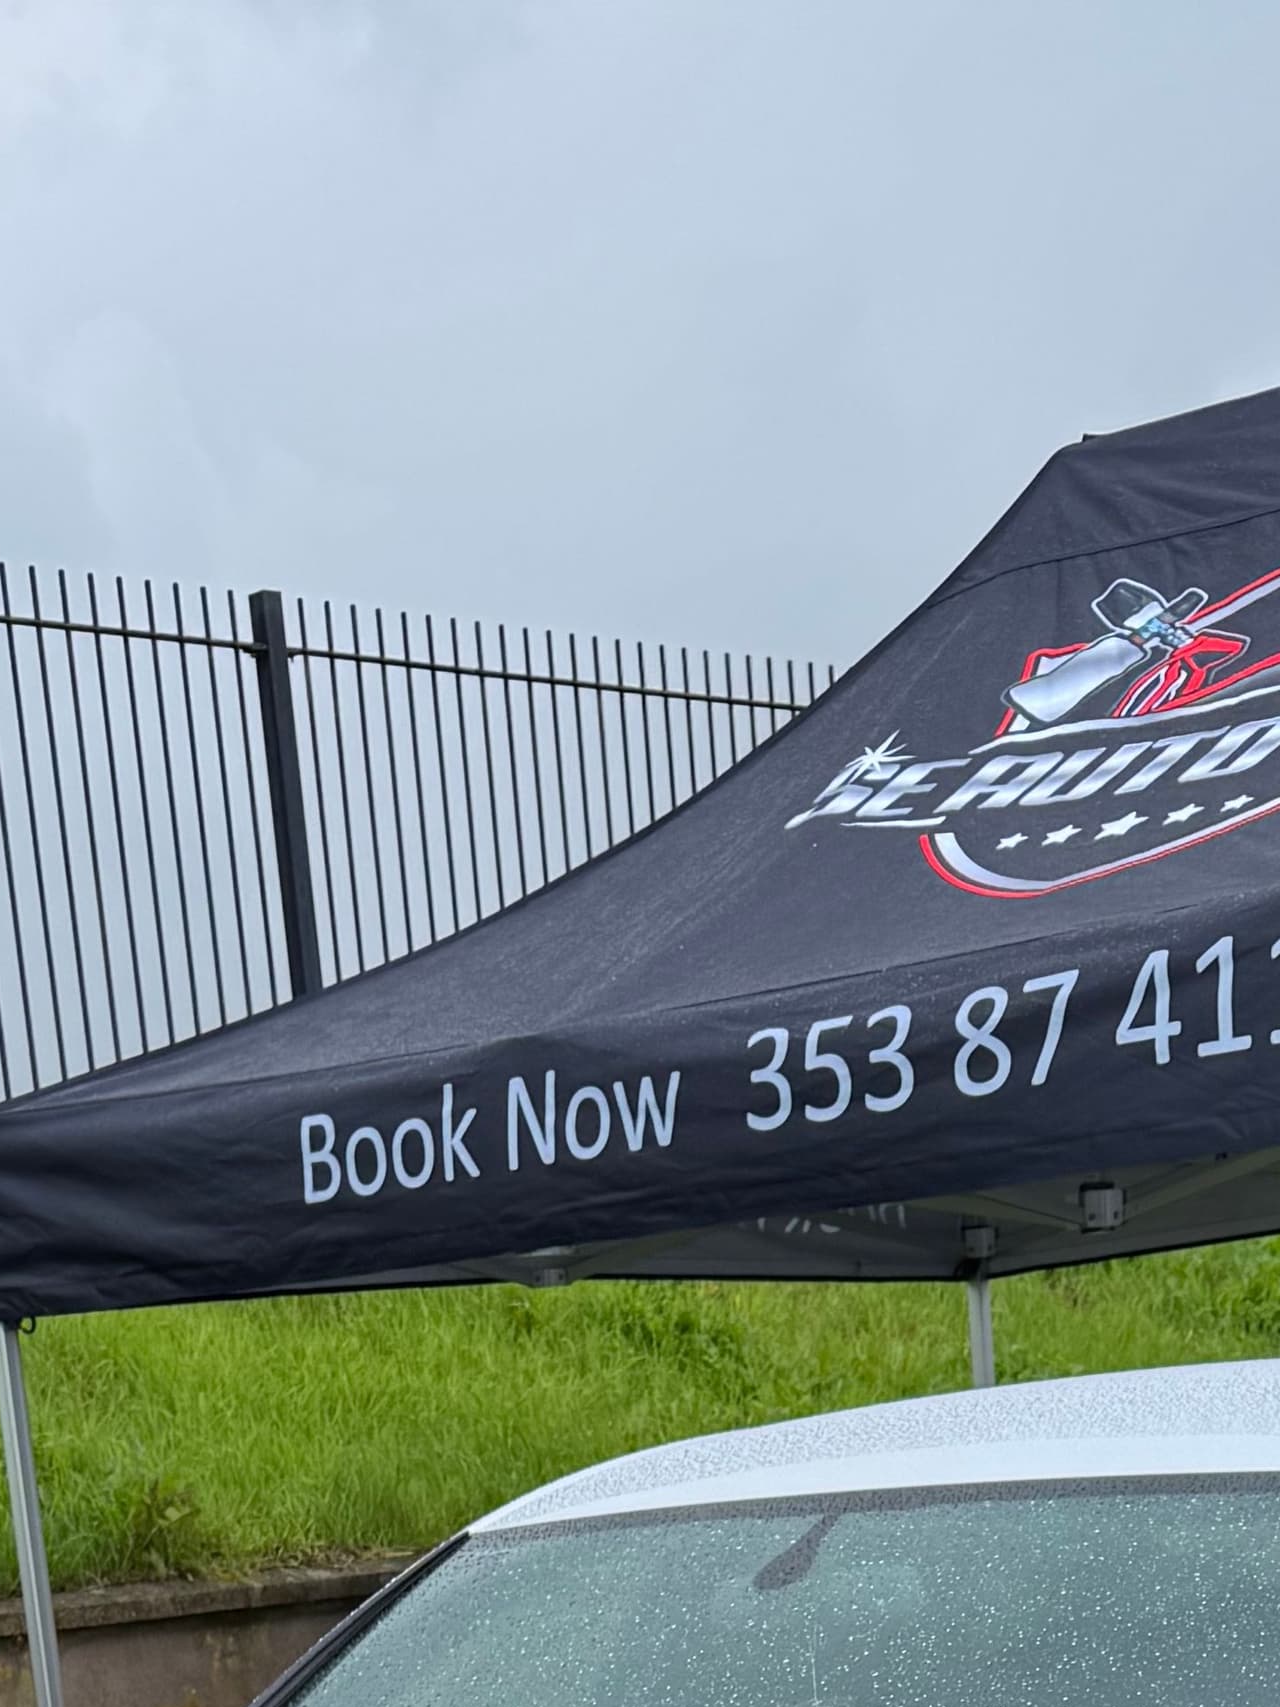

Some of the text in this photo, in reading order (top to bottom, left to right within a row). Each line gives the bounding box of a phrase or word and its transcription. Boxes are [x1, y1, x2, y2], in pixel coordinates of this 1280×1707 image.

[784, 756, 970, 829] SE
[299, 1082, 482, 1205] Book
[506, 1069, 682, 1172] Now
[746, 1003, 915, 1132] 353
[953, 967, 1081, 1098] 87
